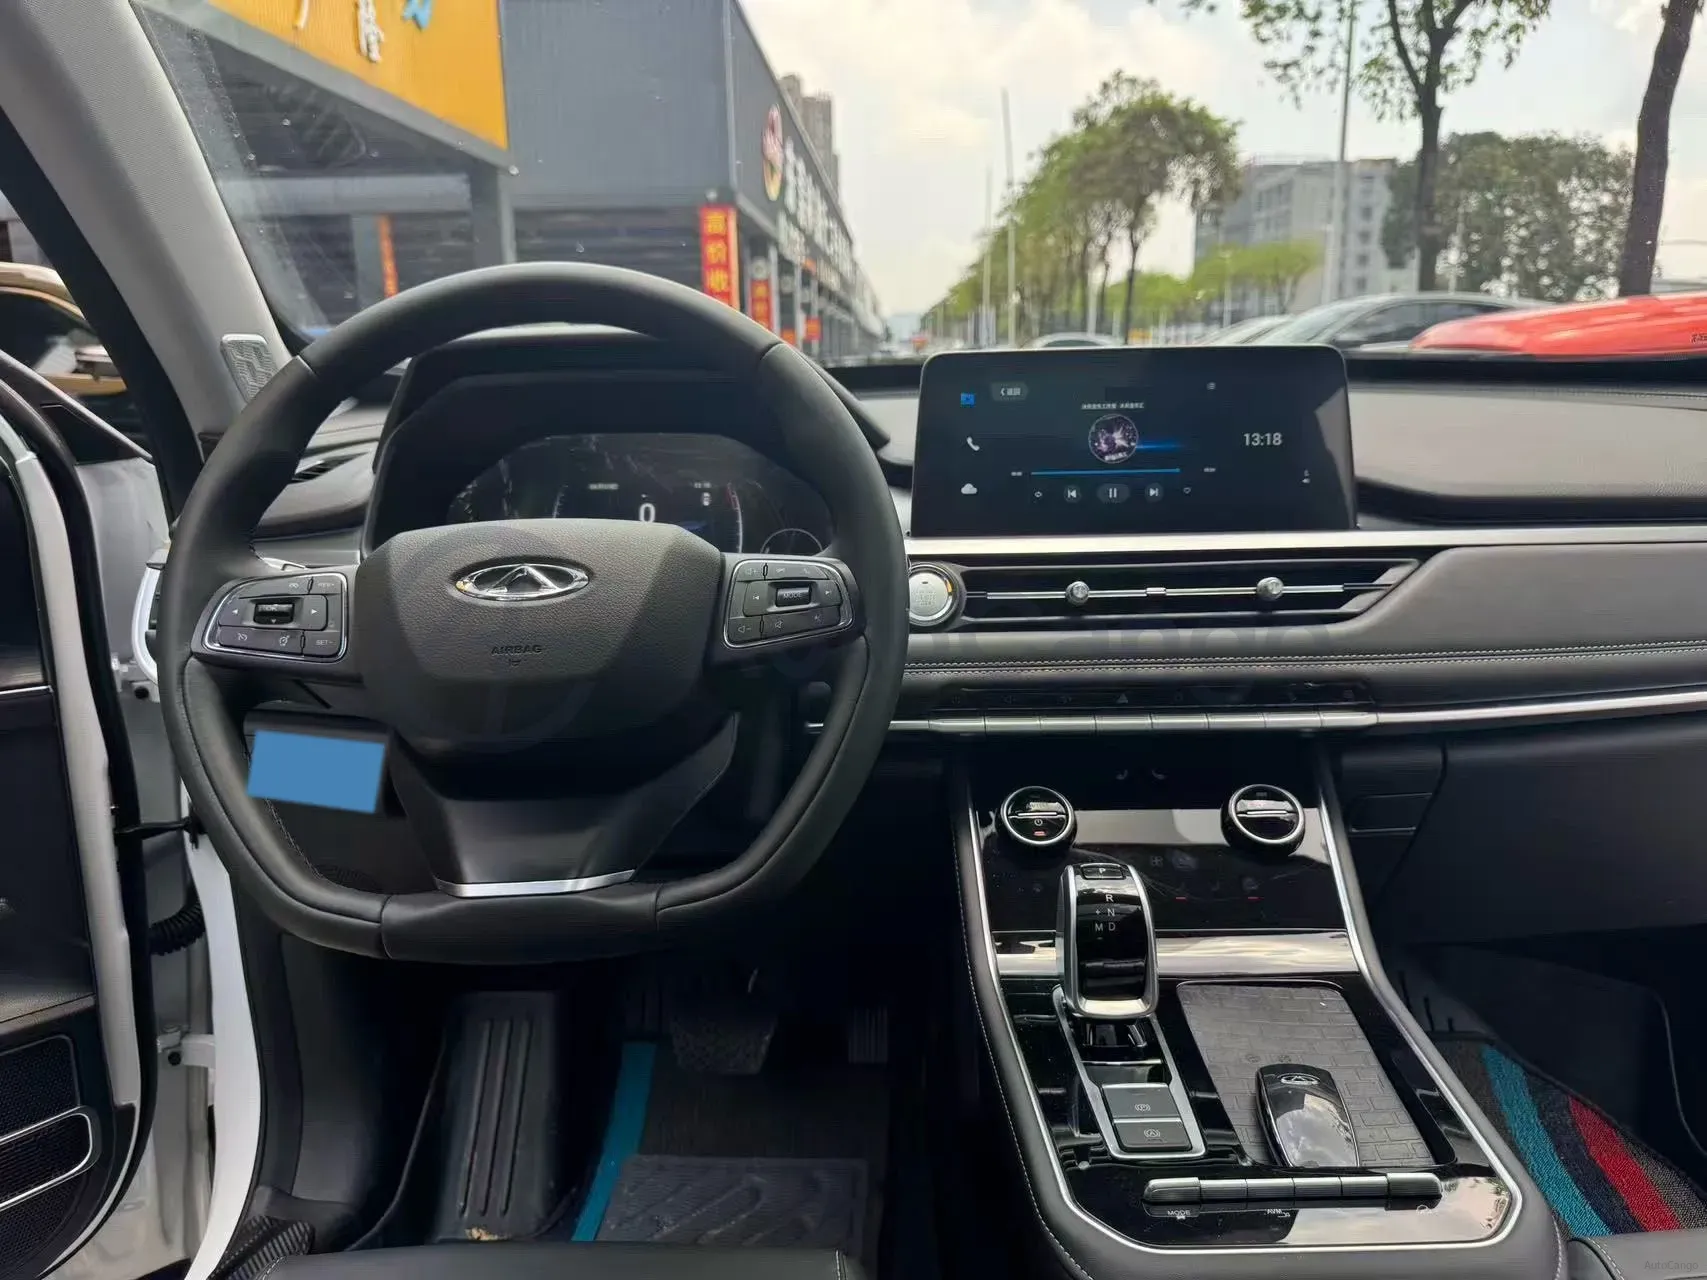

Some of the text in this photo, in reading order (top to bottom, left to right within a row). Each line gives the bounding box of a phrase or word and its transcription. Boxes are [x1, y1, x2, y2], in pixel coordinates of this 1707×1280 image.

[1243, 432, 1283, 447] 13:18
[638, 502, 656, 523] 0
[783, 591, 803, 599] MODE
[490, 645, 543, 655] AIRBAG
[1105, 894, 1114, 902] R
[1107, 908, 1116, 917] N
[1108, 922, 1116, 931] D
[1167, 1209, 1191, 1217] MODE
